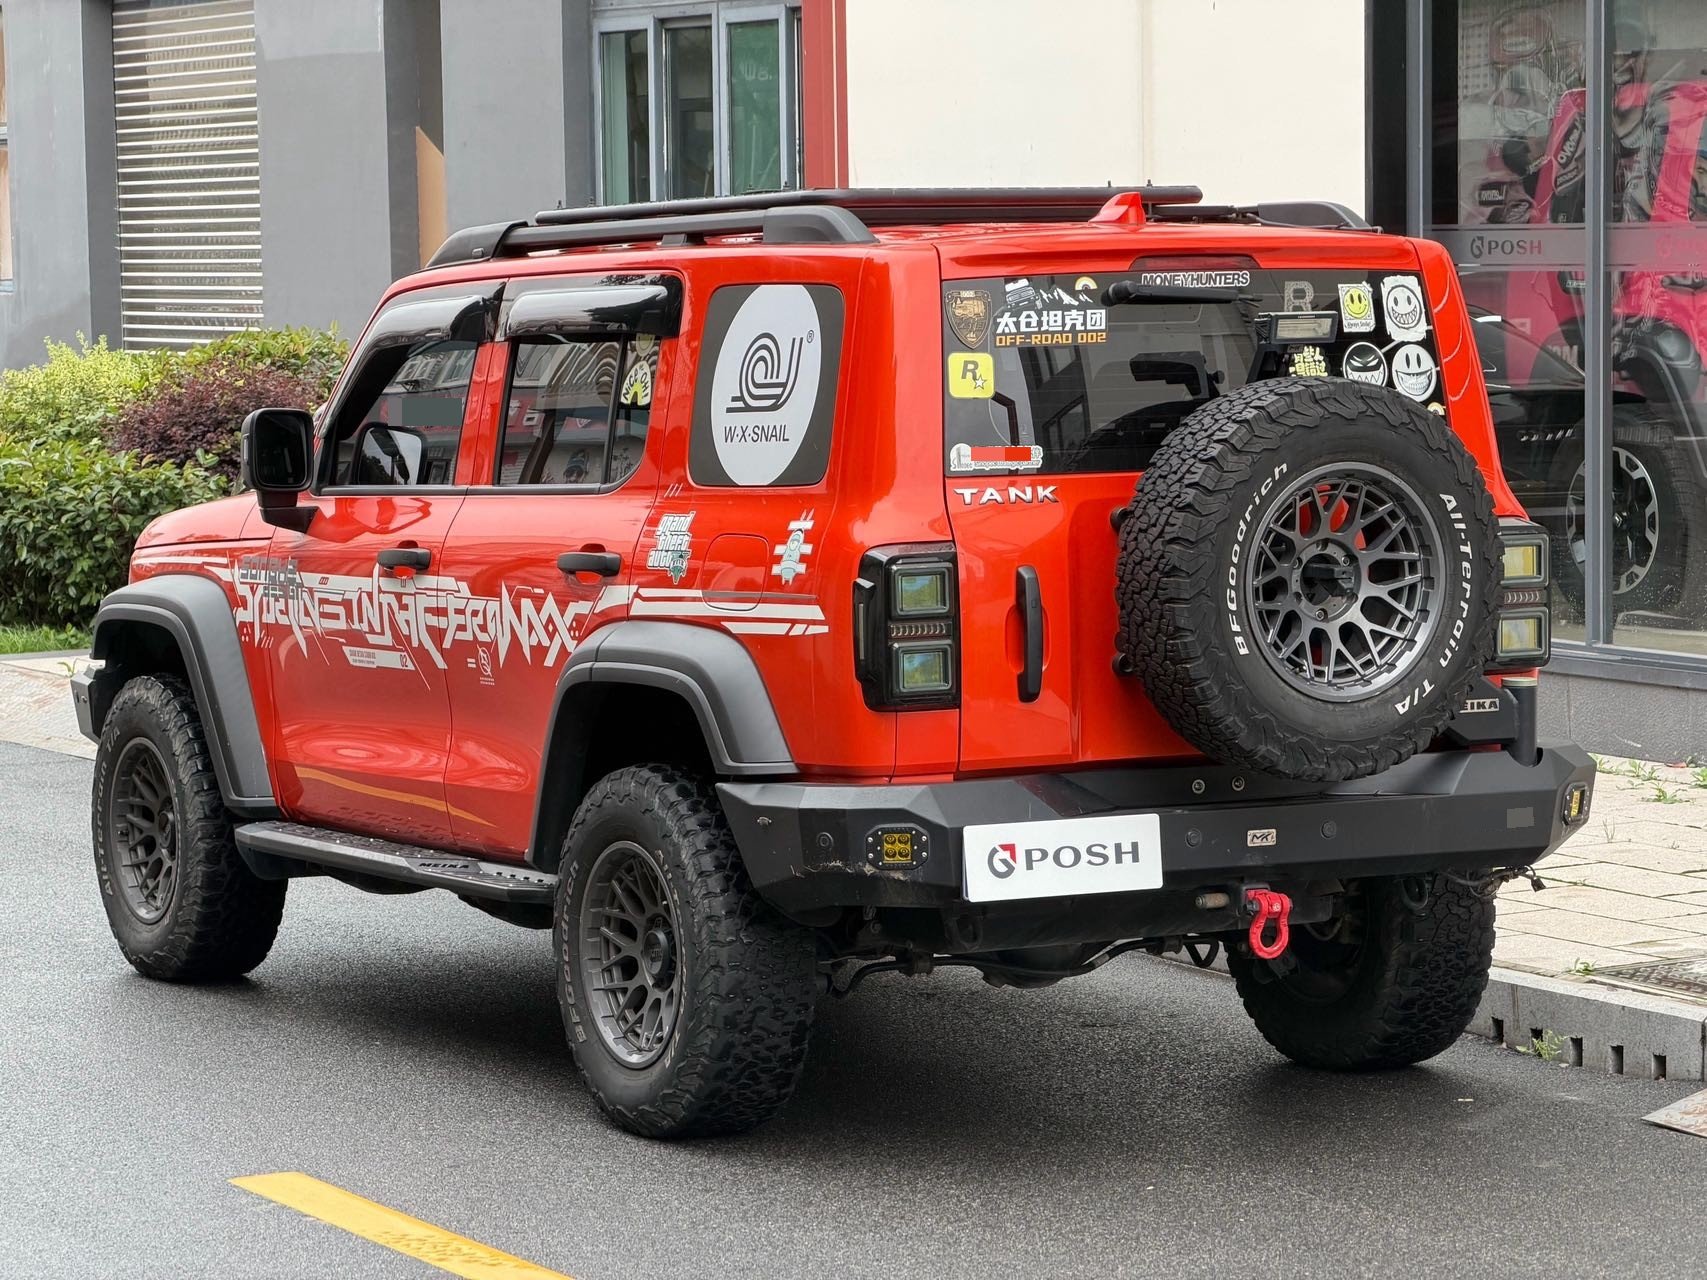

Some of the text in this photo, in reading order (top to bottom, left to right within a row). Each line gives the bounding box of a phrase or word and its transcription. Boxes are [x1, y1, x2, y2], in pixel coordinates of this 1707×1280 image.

[1142, 271, 1249, 287] MONEYHUNTERS
[996, 309, 1106, 334] 太仓坦克团
[995, 333, 1072, 347] OFF-ROAD
[961, 360, 980, 381] R
[953, 486, 1059, 505] TANK
[1226, 462, 1289, 656] BFGoodrich
[1394, 493, 1475, 716] All-Terrain T/A
[1025, 841, 1140, 871] POSH
